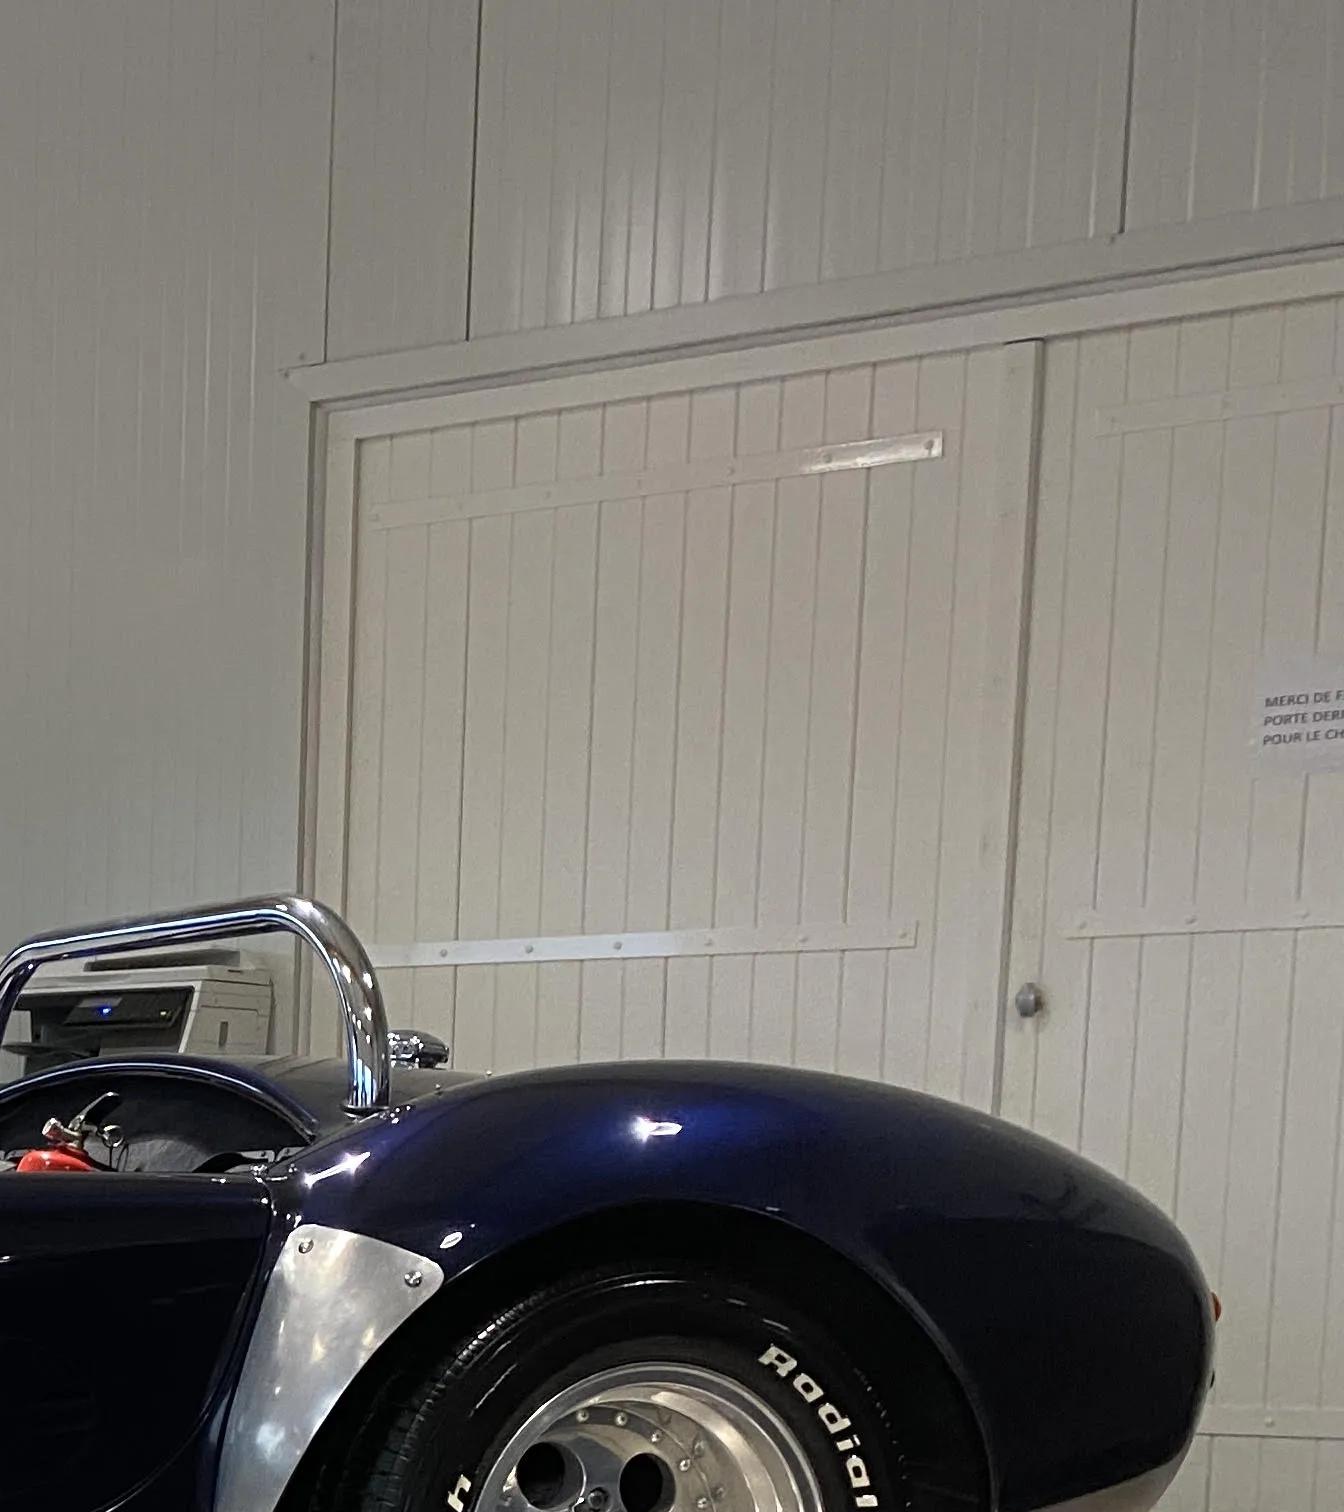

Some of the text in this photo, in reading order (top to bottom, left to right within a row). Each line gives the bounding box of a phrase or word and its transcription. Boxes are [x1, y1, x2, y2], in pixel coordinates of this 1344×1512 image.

[1265, 694, 1309, 707] MERCI
[1313, 691, 1331, 703] DE
[1264, 712, 1308, 726] PORTE
[1263, 732, 1301, 745] POUR
[1306, 730, 1320, 742] LE
[758, 1343, 879, 1508] Radial
